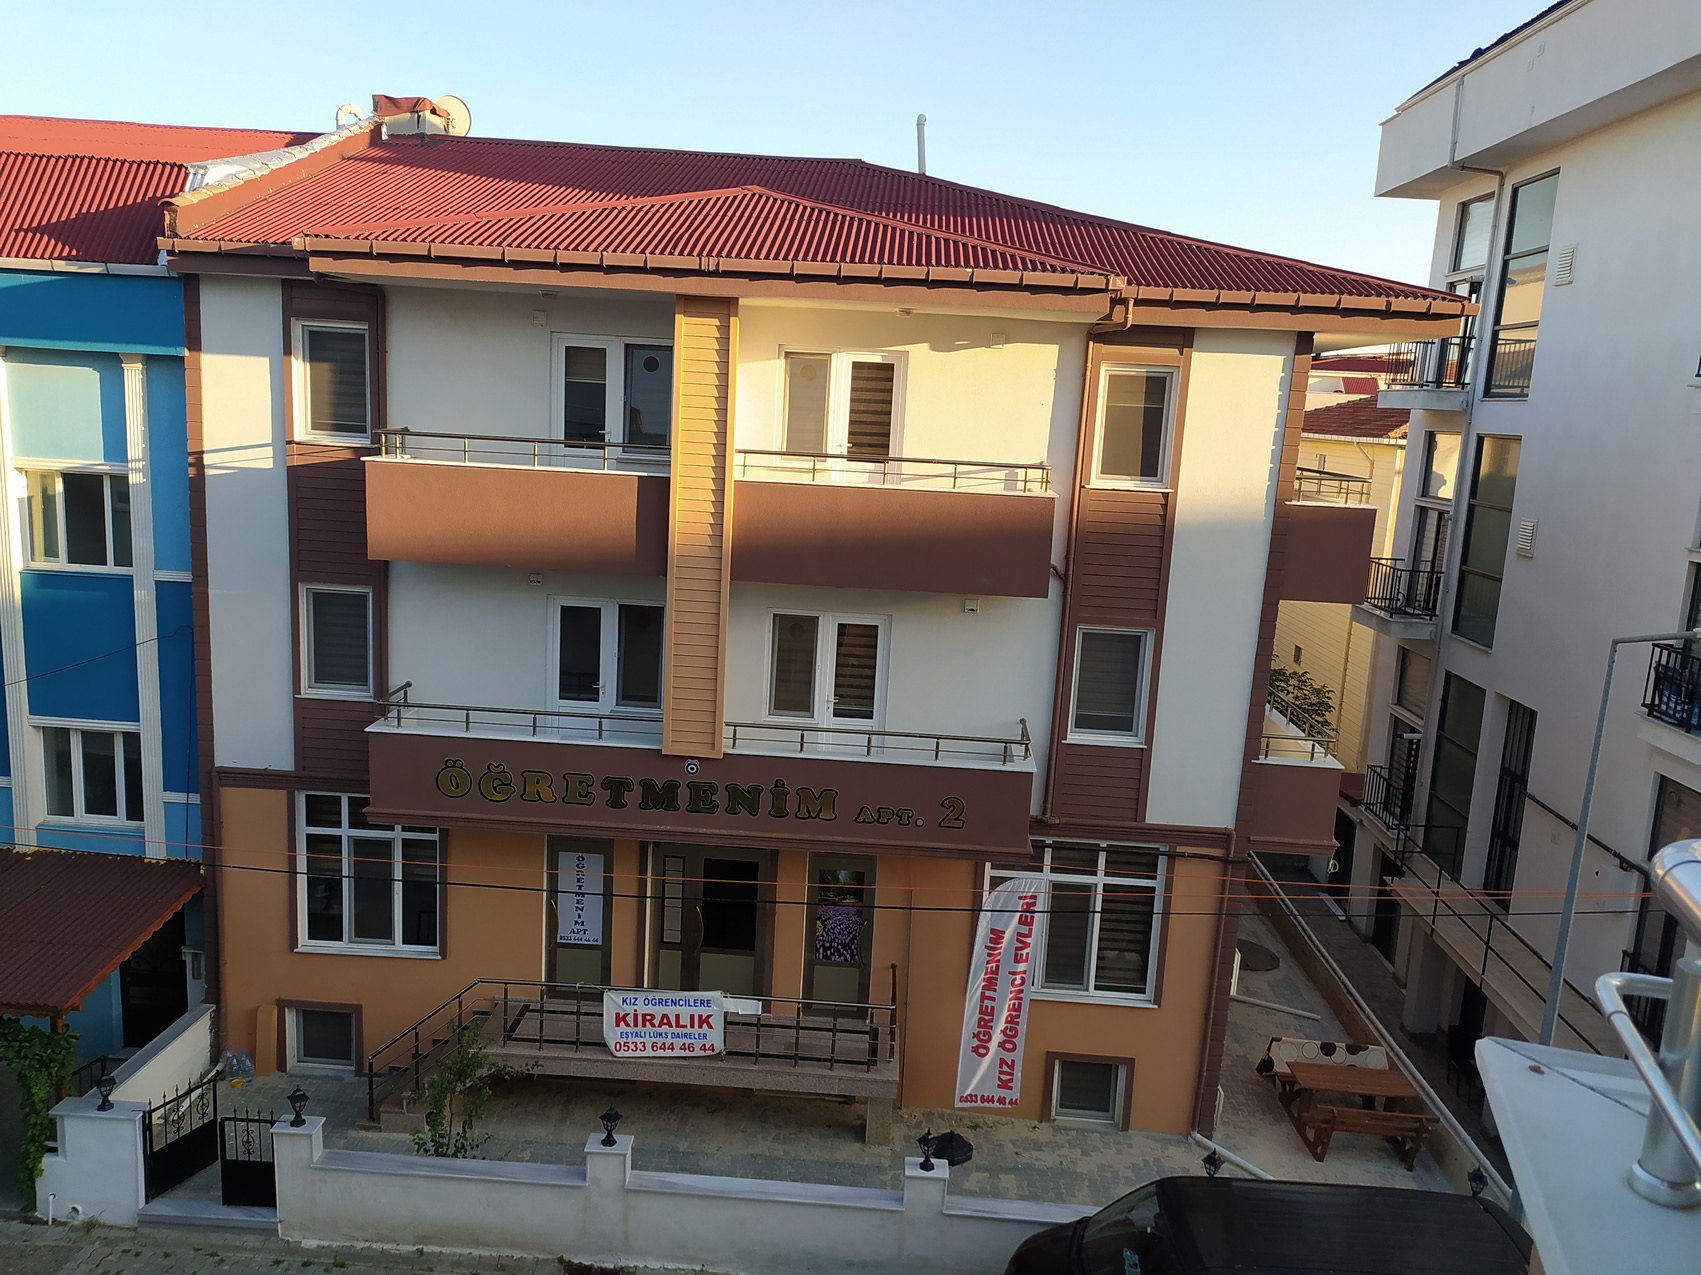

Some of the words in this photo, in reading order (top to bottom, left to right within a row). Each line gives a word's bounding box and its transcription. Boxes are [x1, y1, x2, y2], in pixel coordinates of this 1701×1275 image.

[436, 758, 838, 821] ÖĞRETMENİM
[854, 806, 924, 827] APT.
[938, 796, 965, 829] 2
[1013, 895, 1038, 964] EVLERİ
[621, 996, 639, 1006] KIZ
[643, 995, 712, 1008] ÖĞRENCİLERE
[970, 928, 1006, 1058] ÖĞRETMENİM
[614, 1009, 714, 1030] KİRALIK
[997, 970, 1027, 1053] ÖĞRENCİ
[614, 1041, 647, 1053] 0533
[650, 1042, 675, 1053] 644
[679, 1042, 695, 1053] 46
[699, 1043, 716, 1053] 44
[620, 1031, 647, 1040] EŞYALI
[648, 1030, 669, 1040] LÜKS
[670, 1031, 708, 1041] DAİRELER
[997, 1057, 1015, 1091] KIZ
